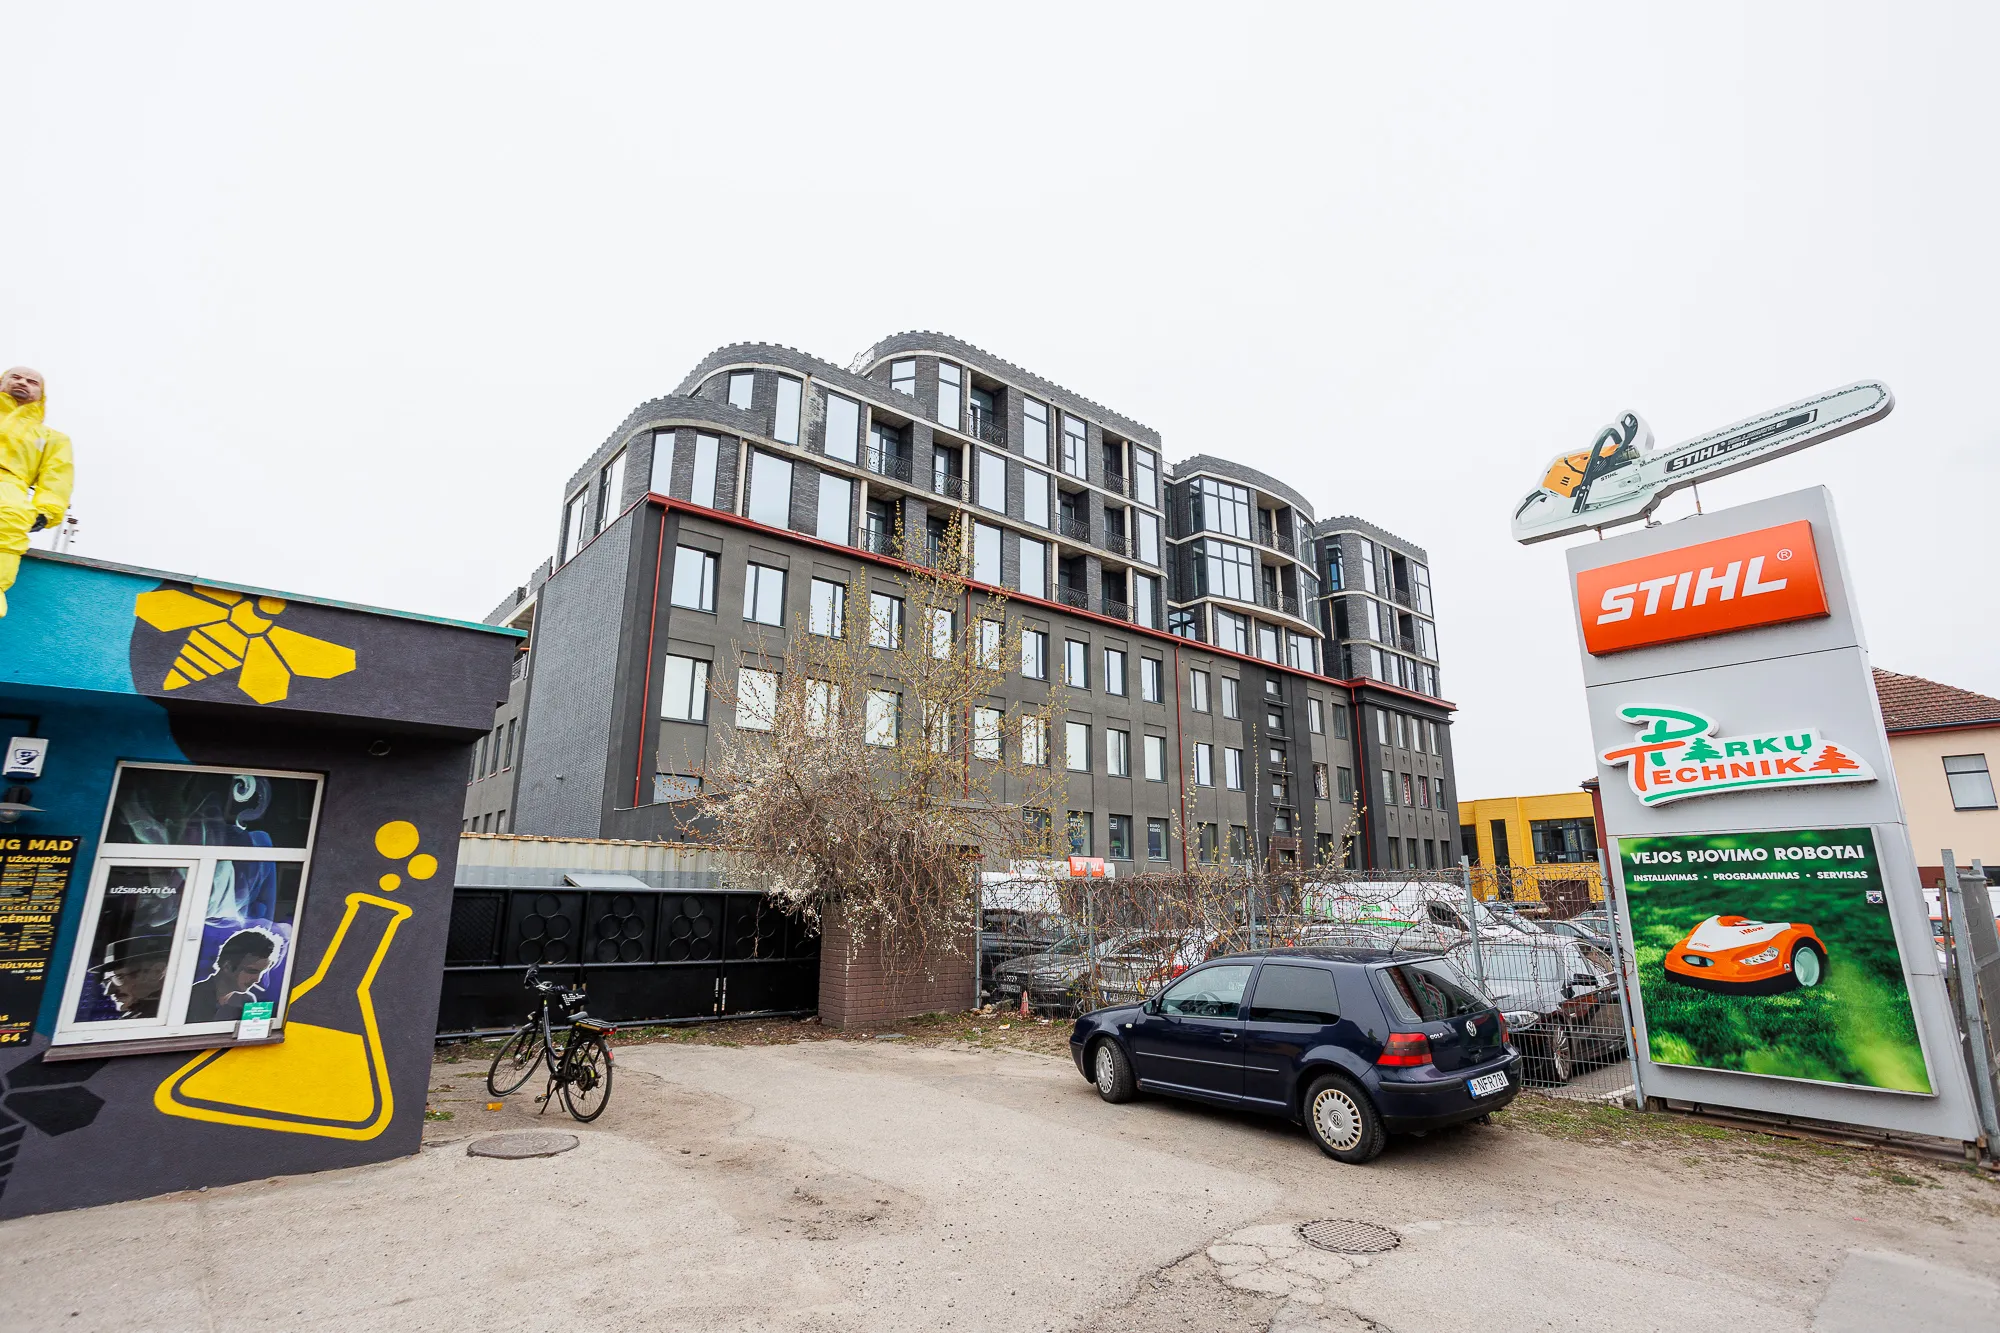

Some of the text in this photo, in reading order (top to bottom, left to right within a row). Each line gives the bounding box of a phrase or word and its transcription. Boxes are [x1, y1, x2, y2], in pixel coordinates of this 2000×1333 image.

[27, 839, 74, 851] MAD
[1630, 845, 1865, 864] VEJOS PJOVIMO ROBOTAI
[1713, 872, 1800, 881] PROGRAMAVIMAS
[1817, 871, 1868, 879] SERVISAS
[110, 885, 177, 894] UŽSIRAŠYTI ČIA
